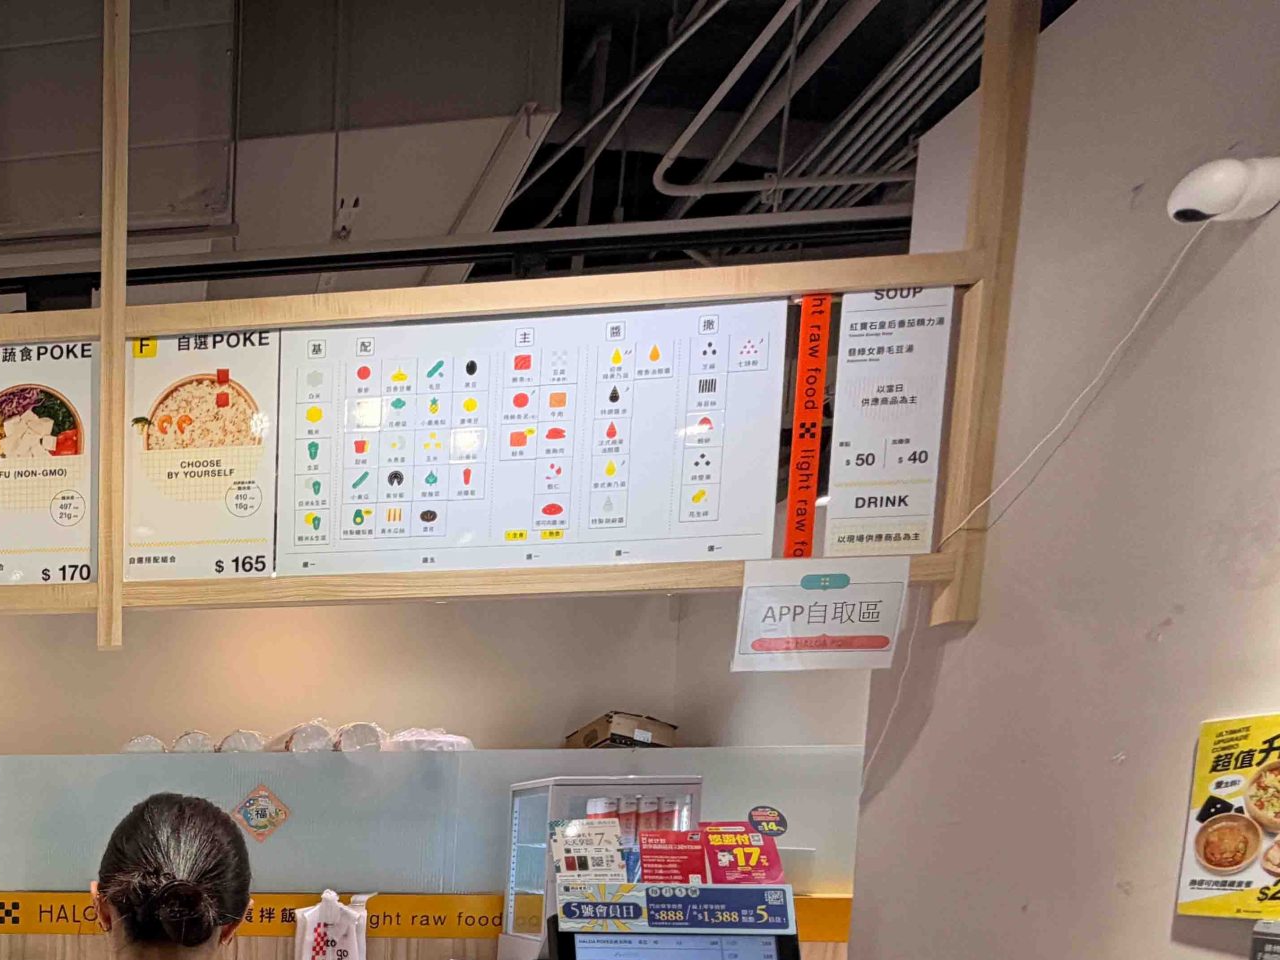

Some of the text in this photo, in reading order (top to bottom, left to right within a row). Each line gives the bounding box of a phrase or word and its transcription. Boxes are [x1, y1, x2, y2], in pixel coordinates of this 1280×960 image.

[139, 338, 151, 354] F
[804, 367, 822, 411] food
[180, 459, 222, 469] CHOOSE
[14, 468, 67, 479] (NON-GMO)
[167, 469, 235, 480] BY YOURSELF
[795, 448, 815, 533] light raw
[854, 495, 909, 509] DRINK
[231, 555, 266, 573] 165
[59, 564, 91, 581] 170
[762, 600, 883, 625] APP自取區
[39, 904, 98, 923] HALO
[369, 911, 402, 930] ght
[411, 915, 448, 926] raw
[457, 911, 503, 927] food
[336, 948, 349, 960] go
